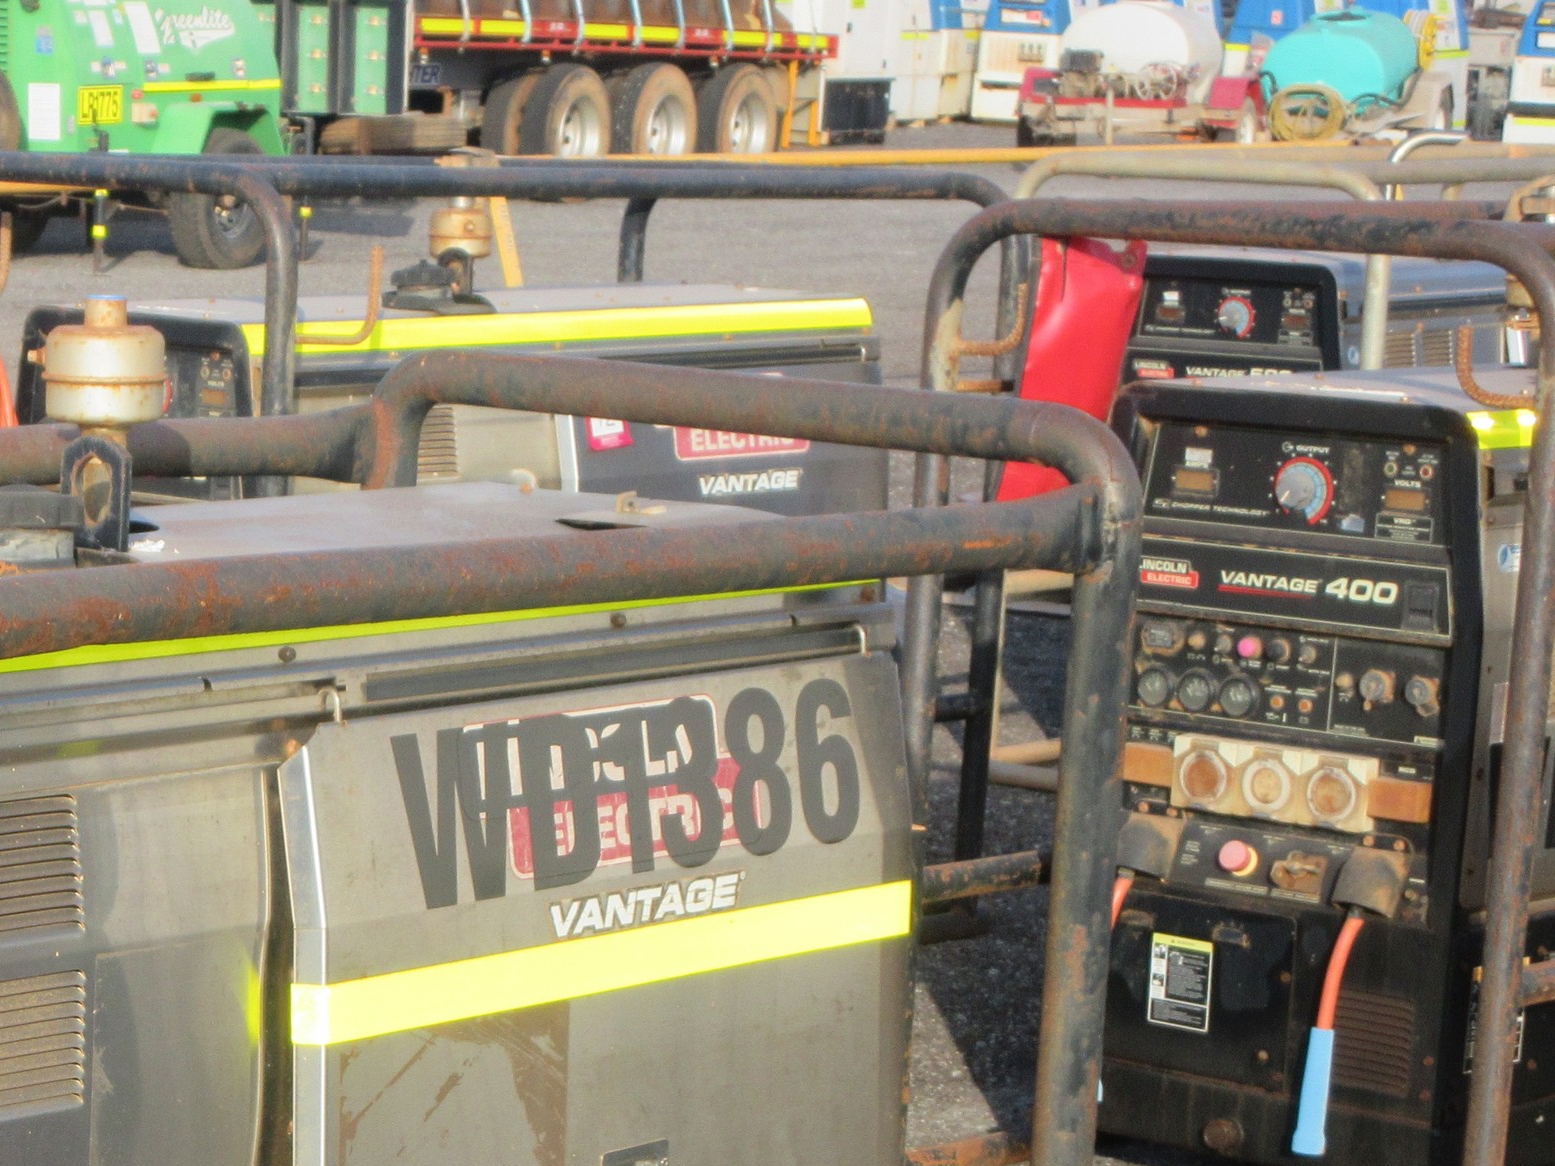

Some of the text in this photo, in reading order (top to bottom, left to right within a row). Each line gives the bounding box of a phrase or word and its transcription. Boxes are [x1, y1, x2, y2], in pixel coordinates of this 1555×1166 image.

[699, 469, 799, 495] VANTAGE
[1140, 558, 1187, 574] INCOLN
[1147, 573, 1192, 586] ELECTRIC
[1220, 570, 1398, 605] VANTAGE 400
[390, 678, 860, 910] WD1386
[550, 874, 741, 938] VANTAGE
